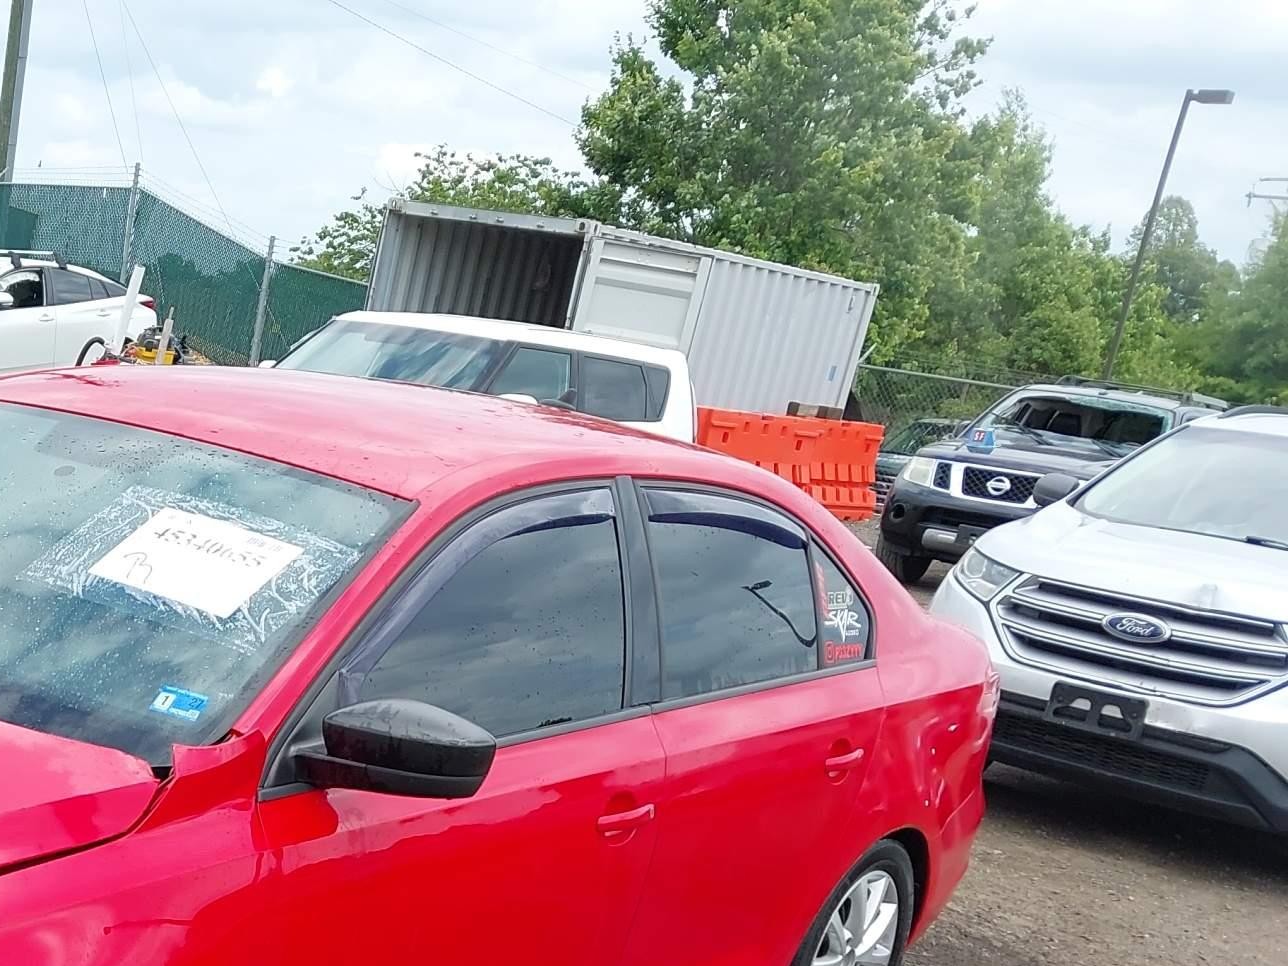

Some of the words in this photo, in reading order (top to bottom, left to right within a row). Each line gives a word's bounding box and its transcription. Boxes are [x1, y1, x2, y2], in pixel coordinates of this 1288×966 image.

[824, 608, 862, 642] SKAR
[1116, 617, 1155, 637] Ford
[188, 697, 205, 709] 27
